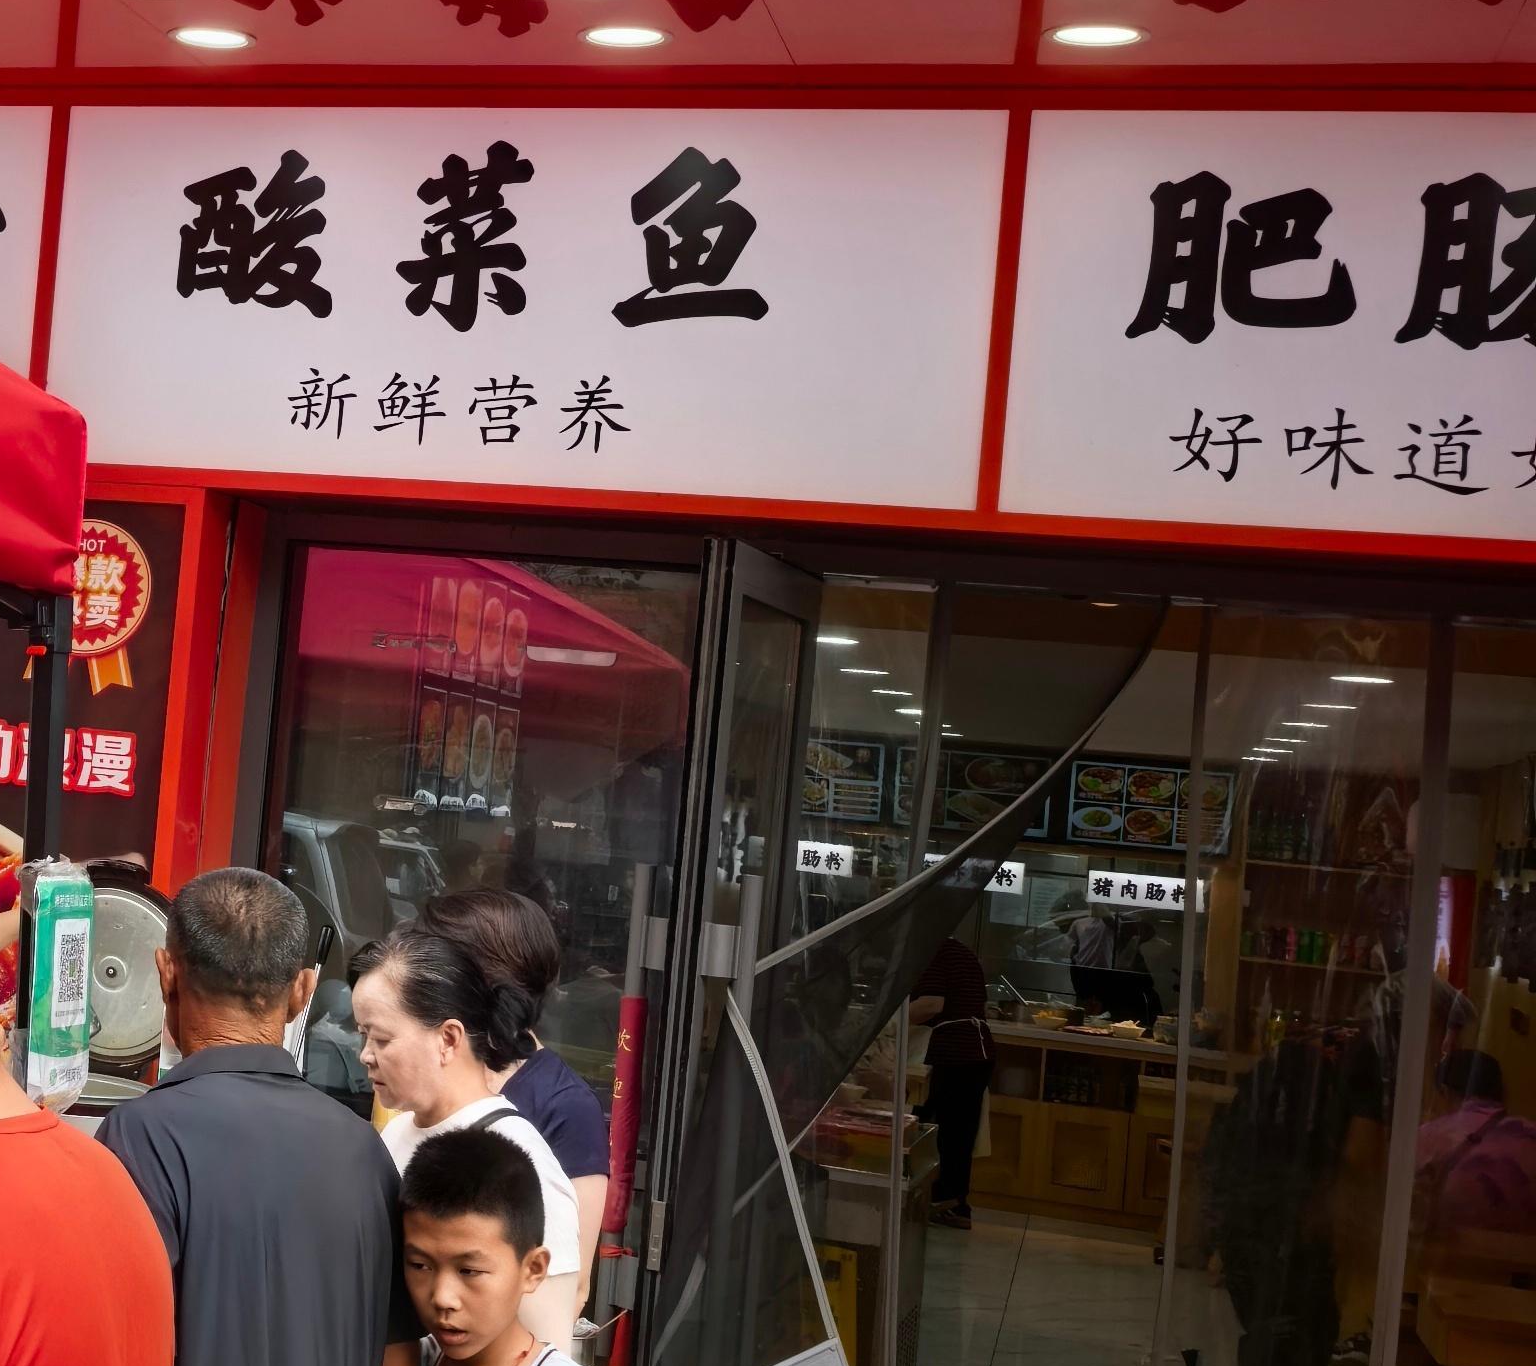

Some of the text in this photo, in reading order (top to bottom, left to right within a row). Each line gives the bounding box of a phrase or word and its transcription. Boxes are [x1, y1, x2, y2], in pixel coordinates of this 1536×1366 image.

[176, 140, 770, 333] 酸菜鱼
[287, 368, 632, 453] 新鲜营养
[1168, 407, 1536, 495] 好味道
[73, 593, 120, 628] 卖
[800, 849, 844, 871] 肠粉
